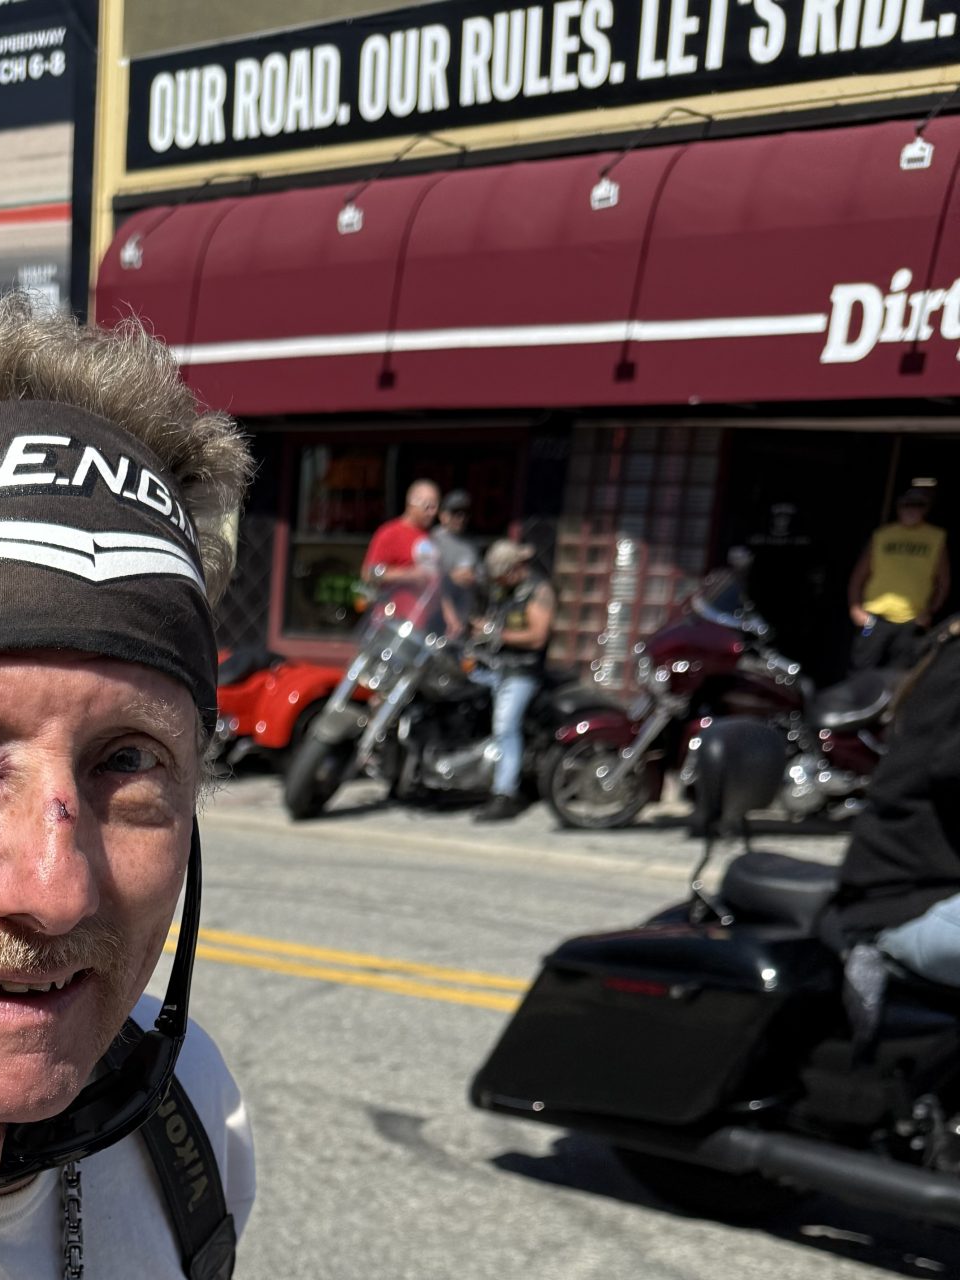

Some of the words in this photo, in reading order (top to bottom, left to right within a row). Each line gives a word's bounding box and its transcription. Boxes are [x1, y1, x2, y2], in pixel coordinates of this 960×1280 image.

[28, 50, 66, 80] 6-8
[148, 64, 227, 153] OUR
[232, 44, 351, 140] ROAD.
[358, 24, 451, 121] OUR
[459, 0, 626, 106] RULES.
[636, 0, 786, 80] LET'S
